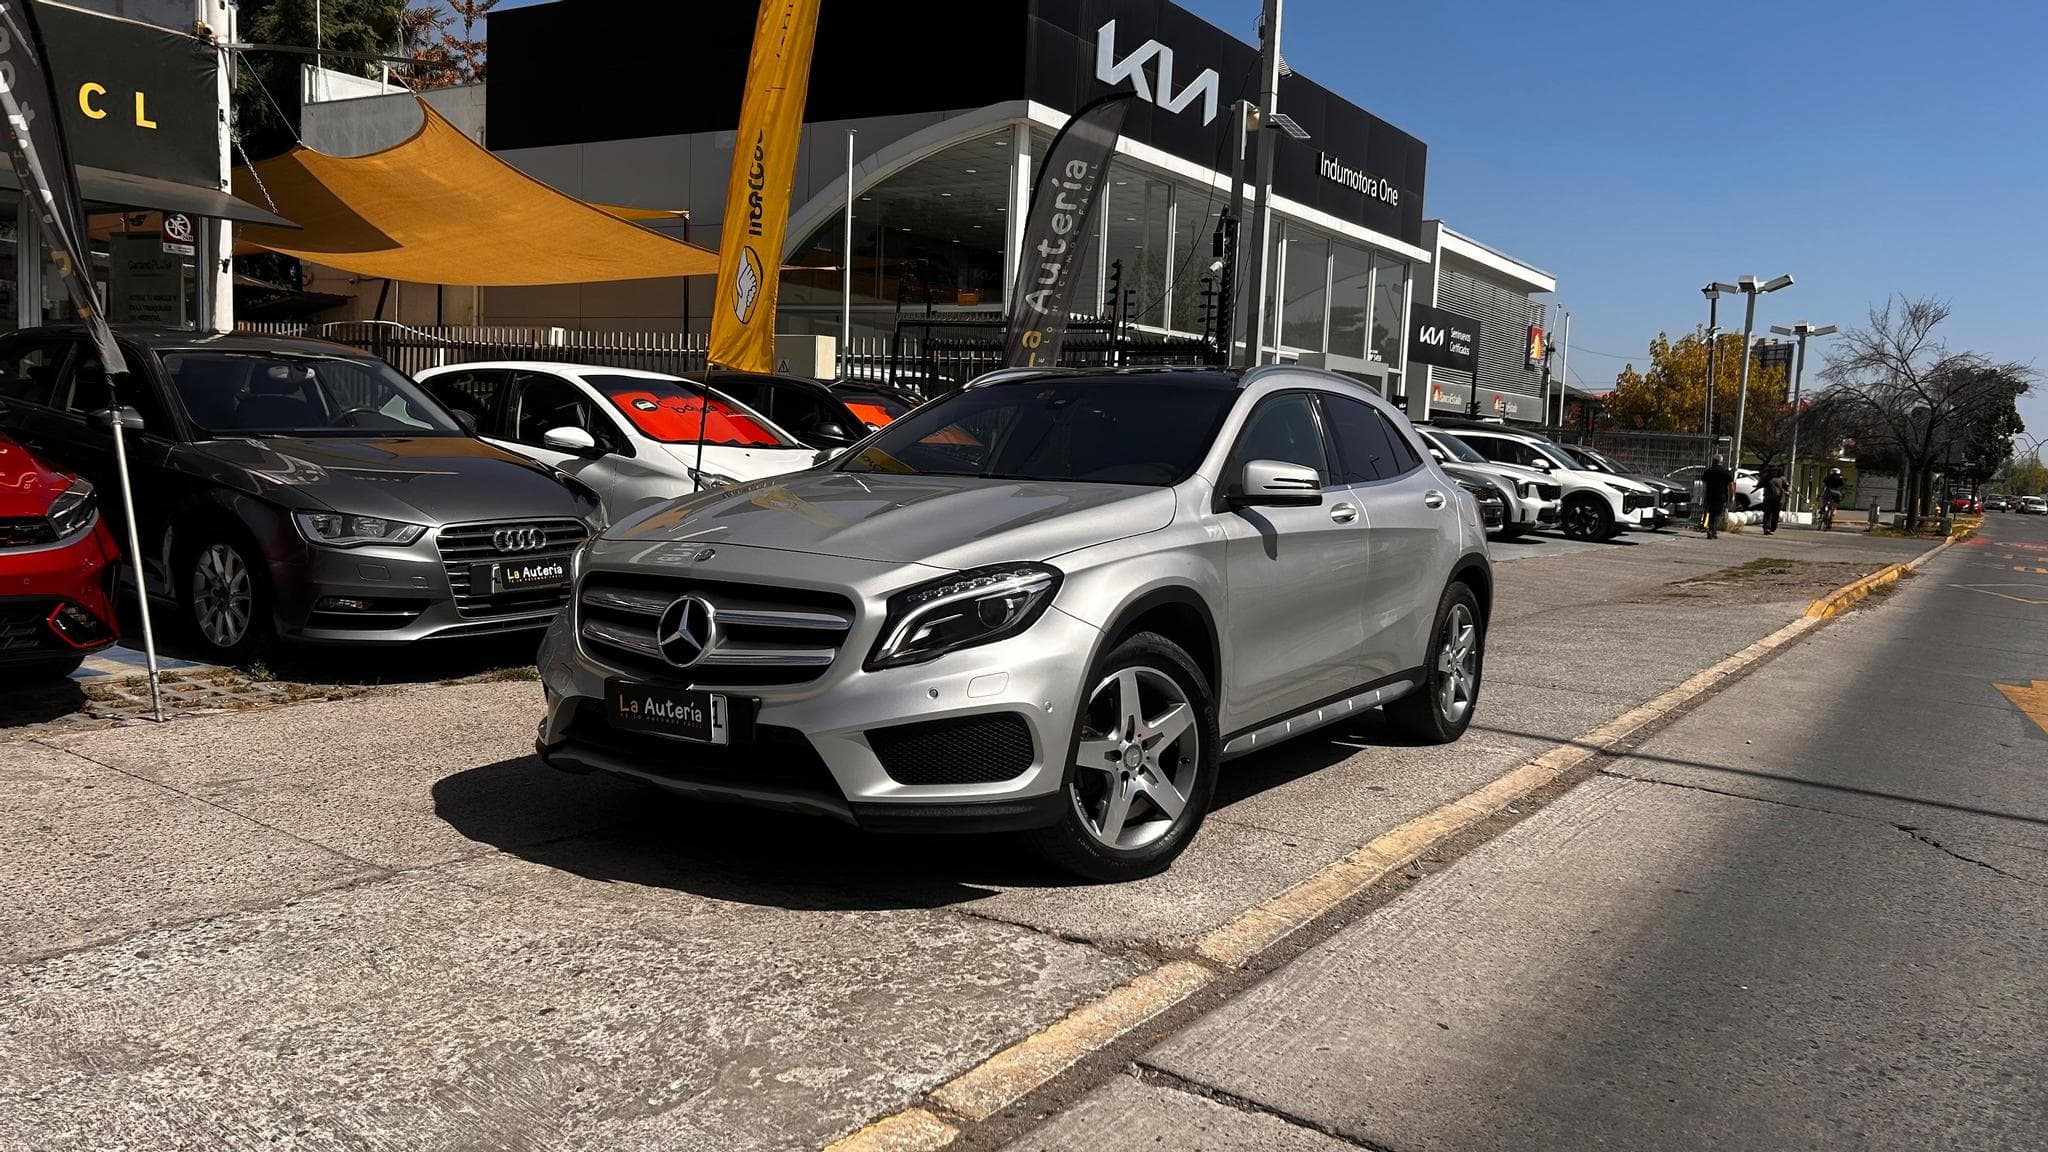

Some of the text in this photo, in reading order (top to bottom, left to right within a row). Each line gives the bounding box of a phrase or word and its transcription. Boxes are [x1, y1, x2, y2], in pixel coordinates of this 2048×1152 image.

[1096, 19, 1219, 127] KIA
[1320, 151, 1399, 206] Indumotora One
[1025, 159, 1088, 315] Autería
[1052, 229, 1080, 312] HACEMOS
[1420, 325, 1445, 346] KIA
[506, 568, 520, 580] La
[522, 562, 563, 578] Autería
[618, 694, 639, 713] La
[644, 697, 702, 722] Autería
